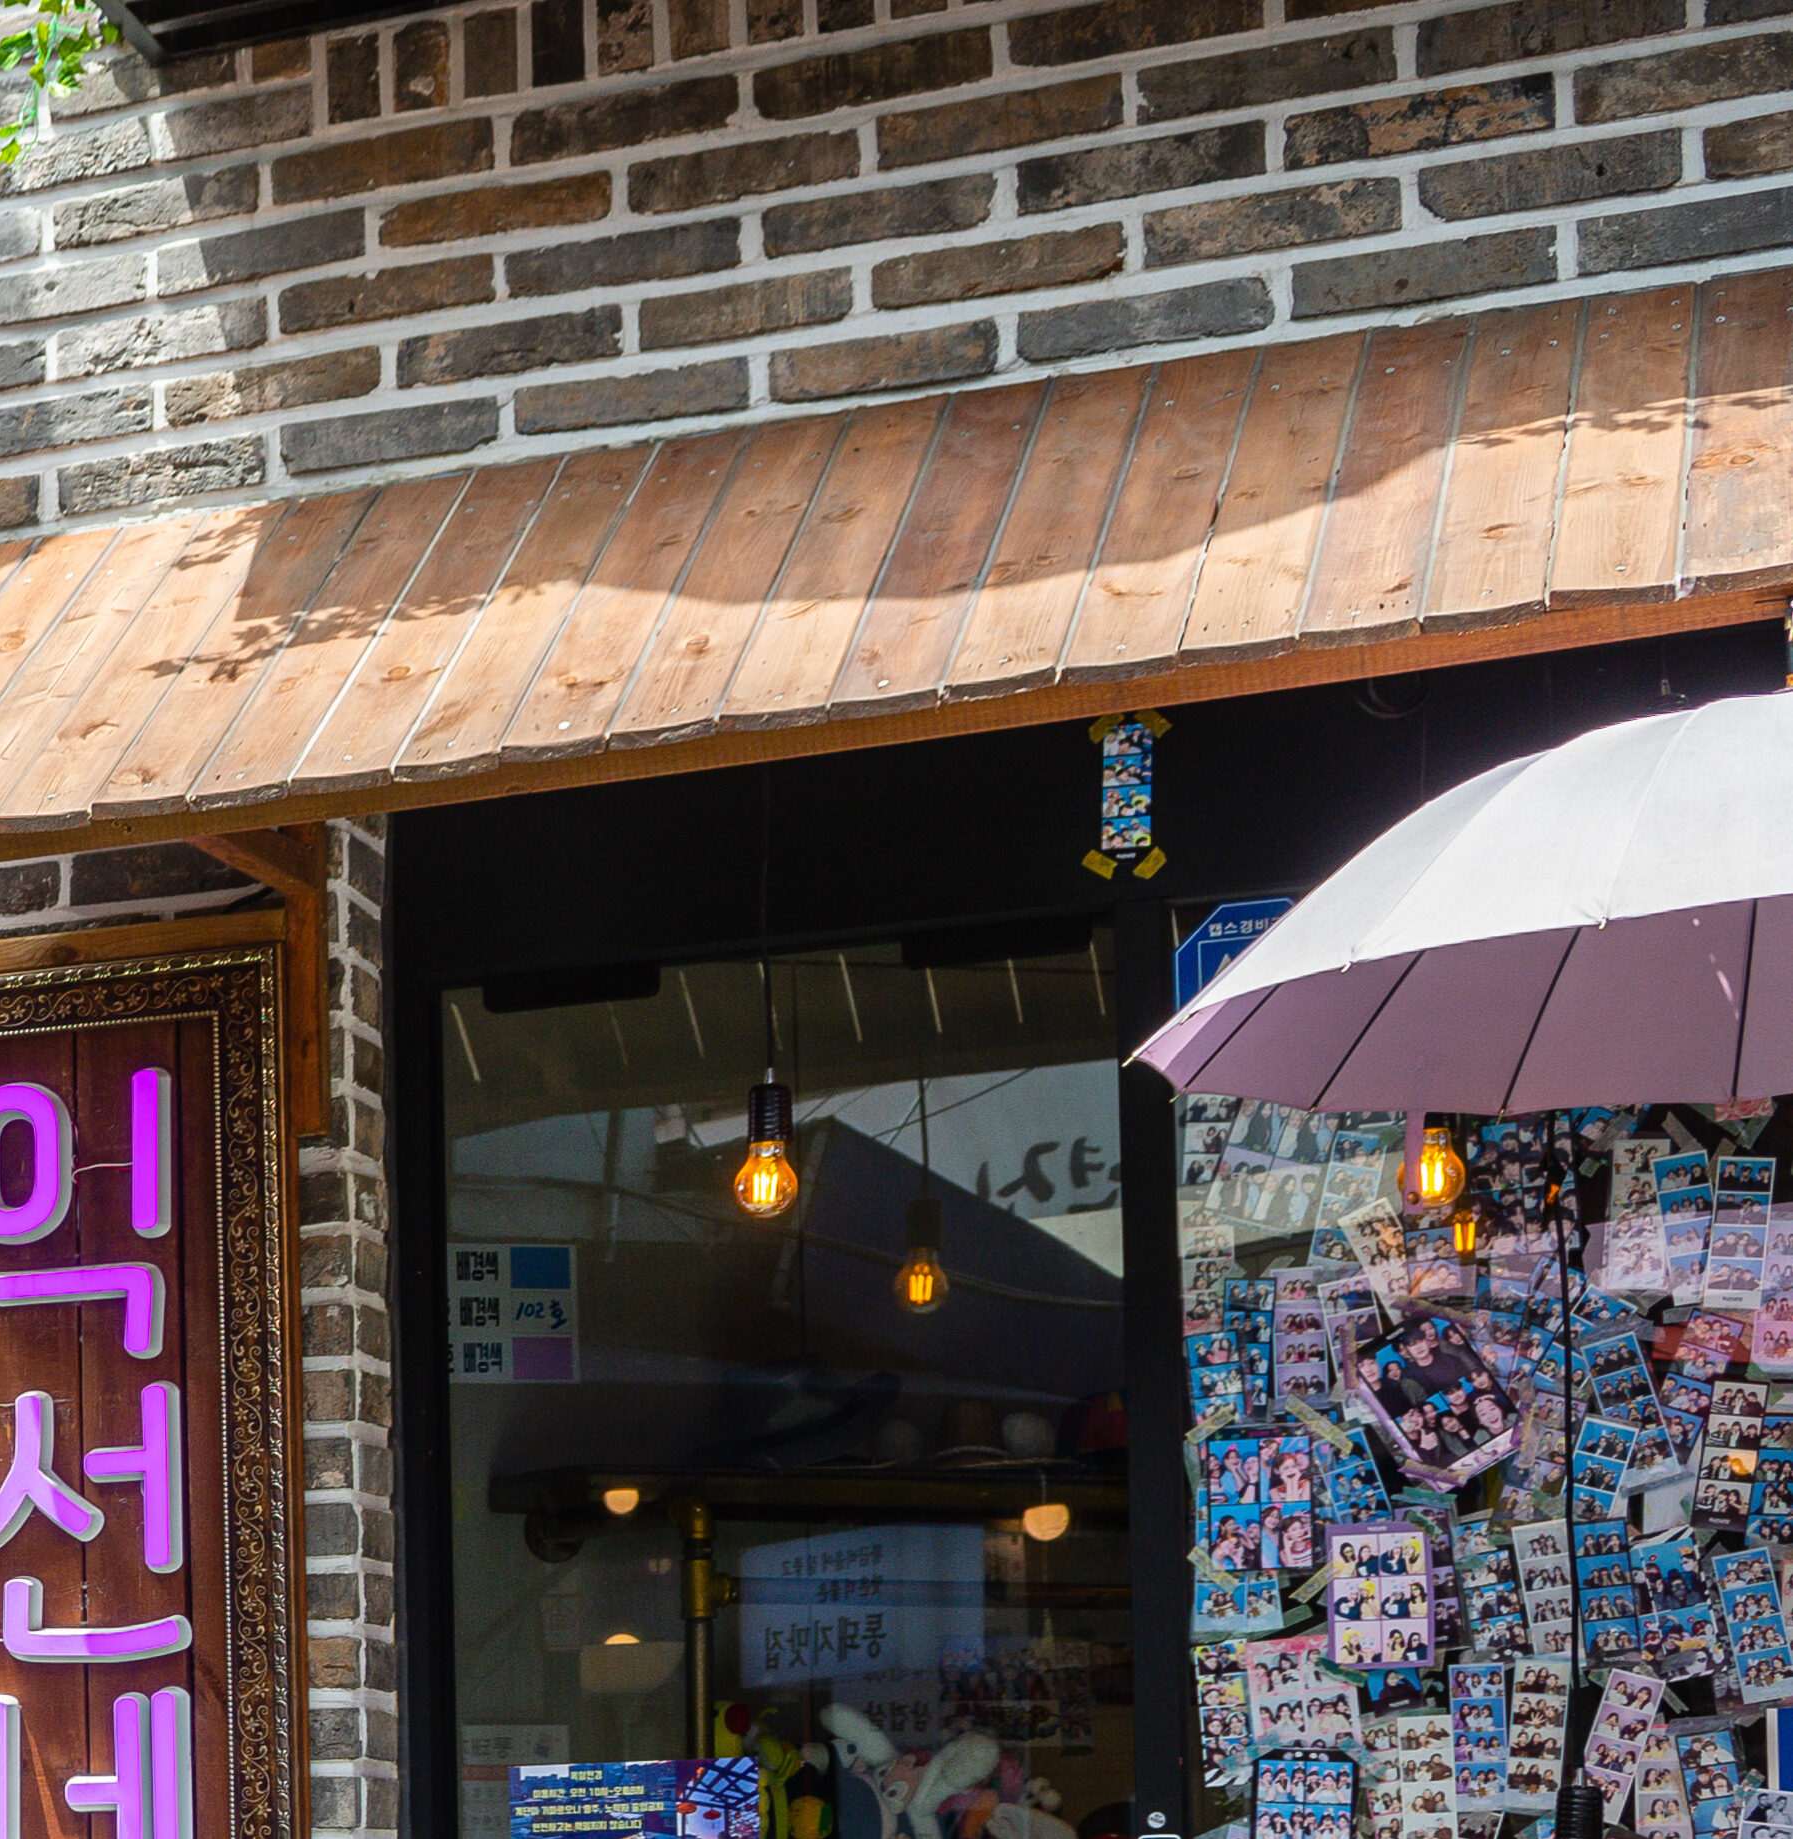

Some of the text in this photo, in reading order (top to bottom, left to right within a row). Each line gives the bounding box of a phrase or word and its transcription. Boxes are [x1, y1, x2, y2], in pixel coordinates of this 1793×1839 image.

[456, 1251, 499, 1281] 배경색
[460, 1297, 567, 1330] 배경색 102호
[464, 1342, 503, 1373] 배경색
